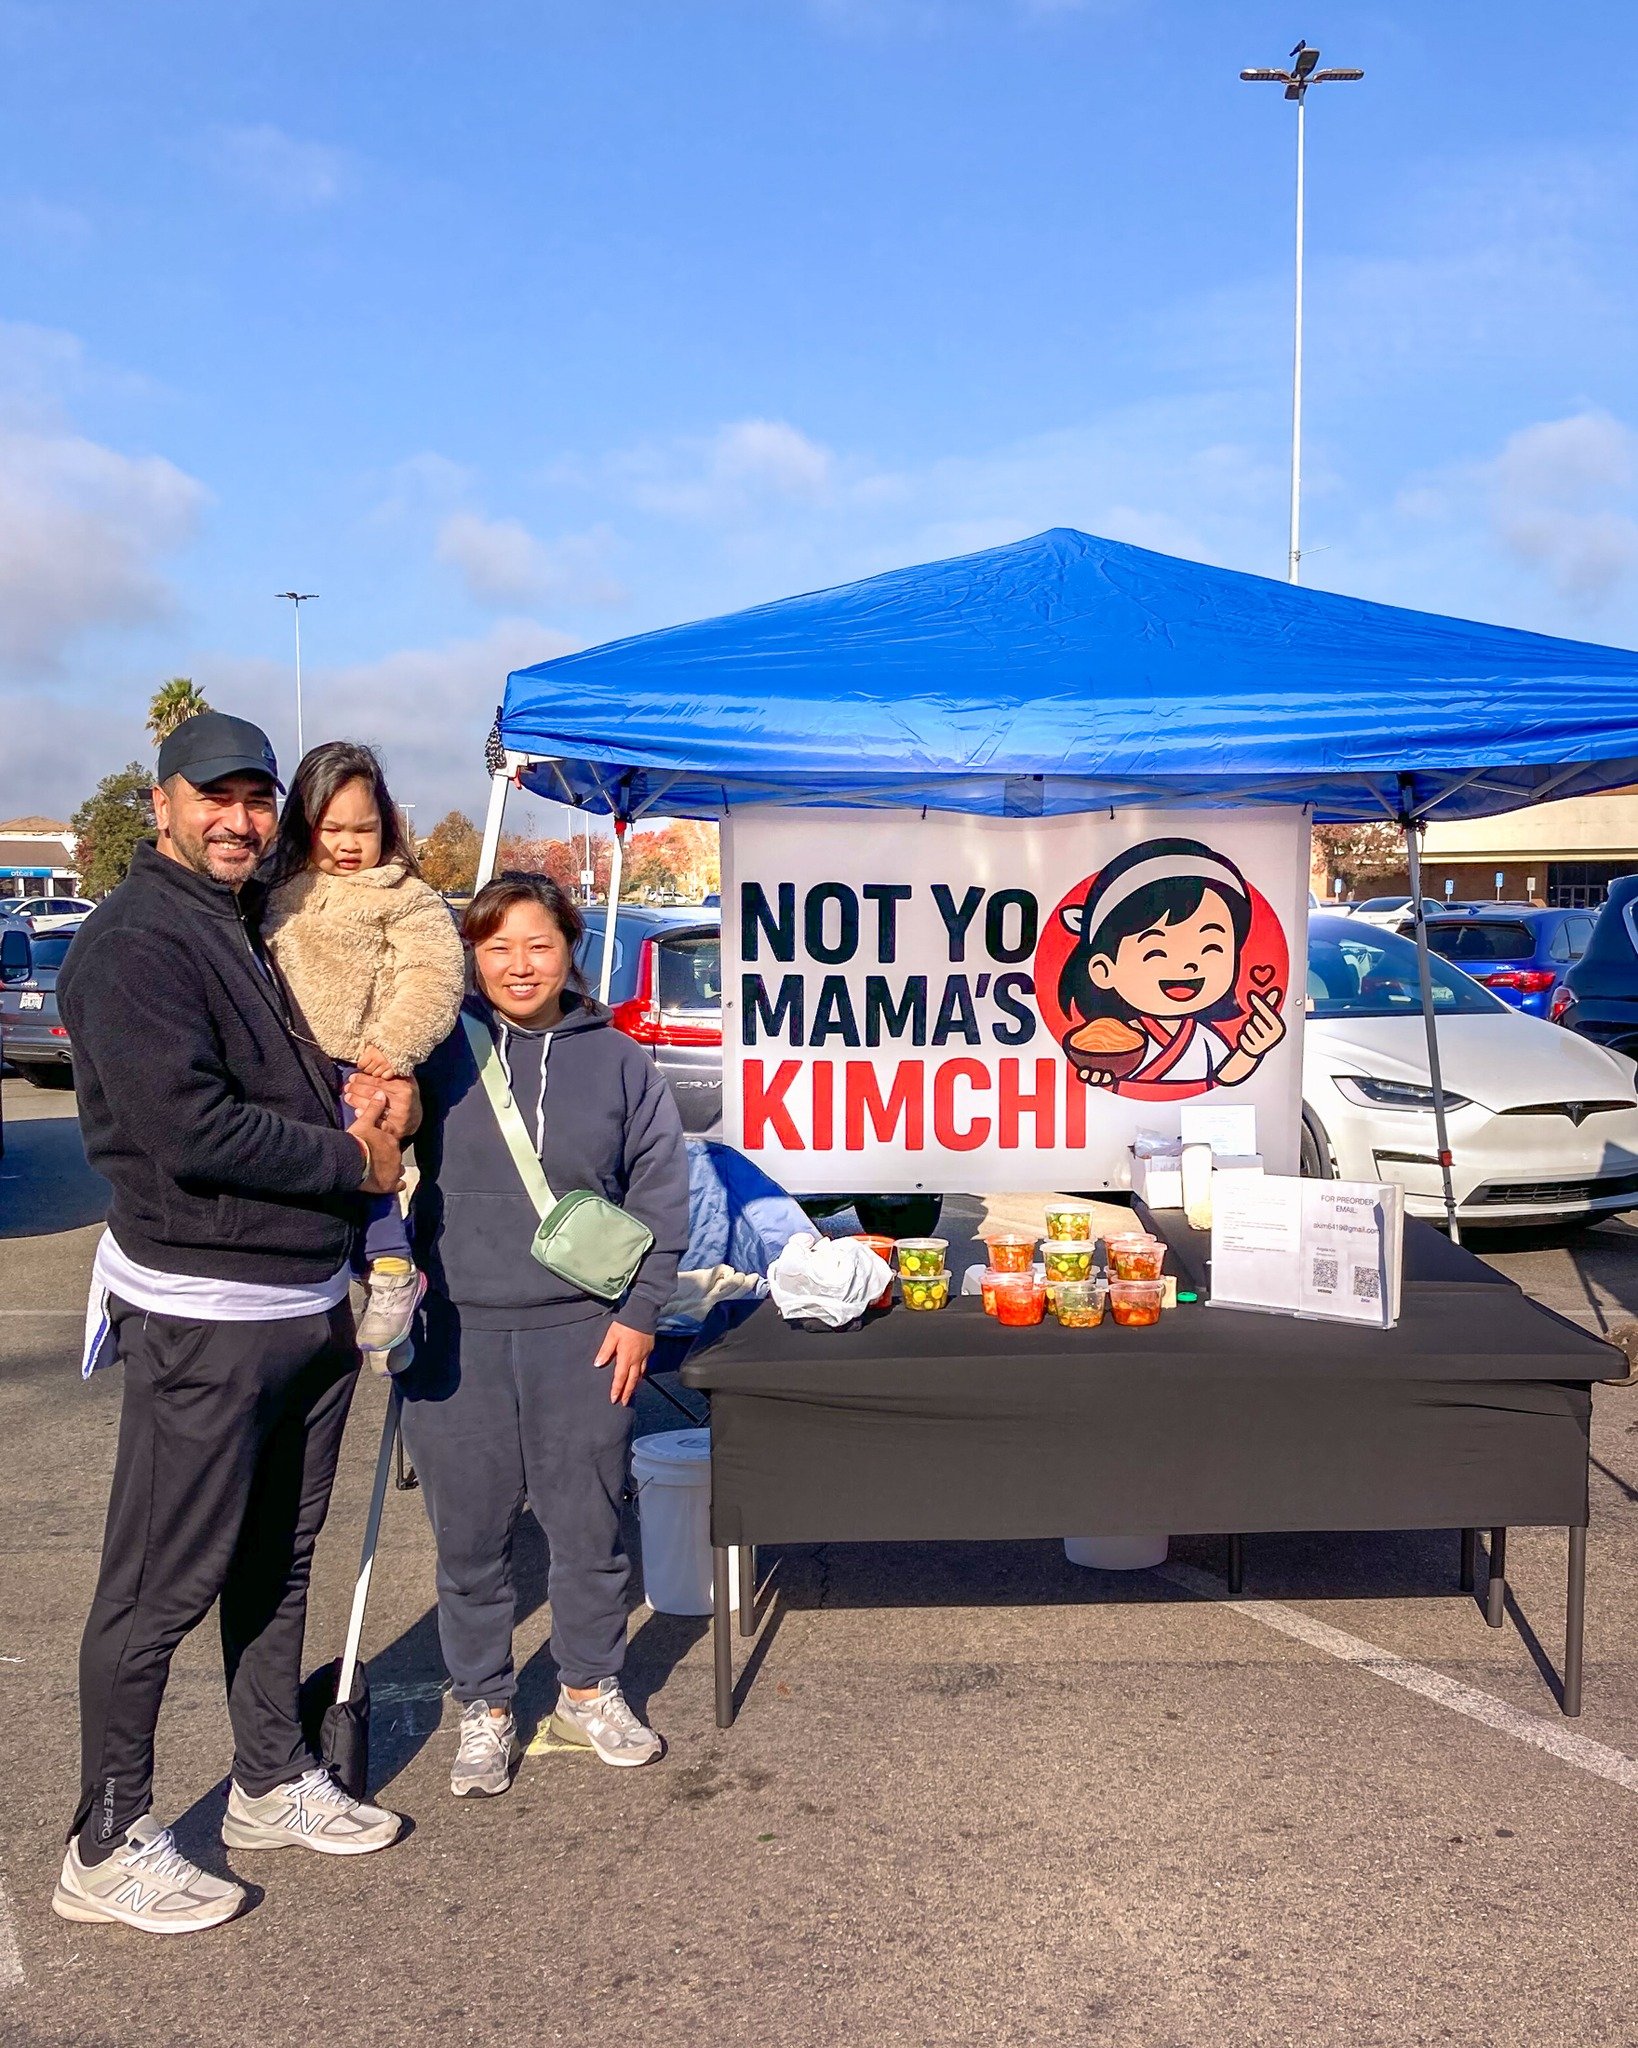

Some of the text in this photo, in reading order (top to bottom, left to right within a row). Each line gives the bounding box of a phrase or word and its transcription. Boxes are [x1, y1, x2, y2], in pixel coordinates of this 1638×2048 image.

[741, 882, 1038, 964] NOT YO
[742, 973, 1037, 1047] MAMA'S
[676, 1080, 722, 1089] CR-V
[743, 1058, 1087, 1151] KIMCHI
[1321, 1194, 1374, 1206] FOR PREORDER
[101, 1777, 116, 1839] NIKE PRO
[115, 1880, 160, 1913] N
